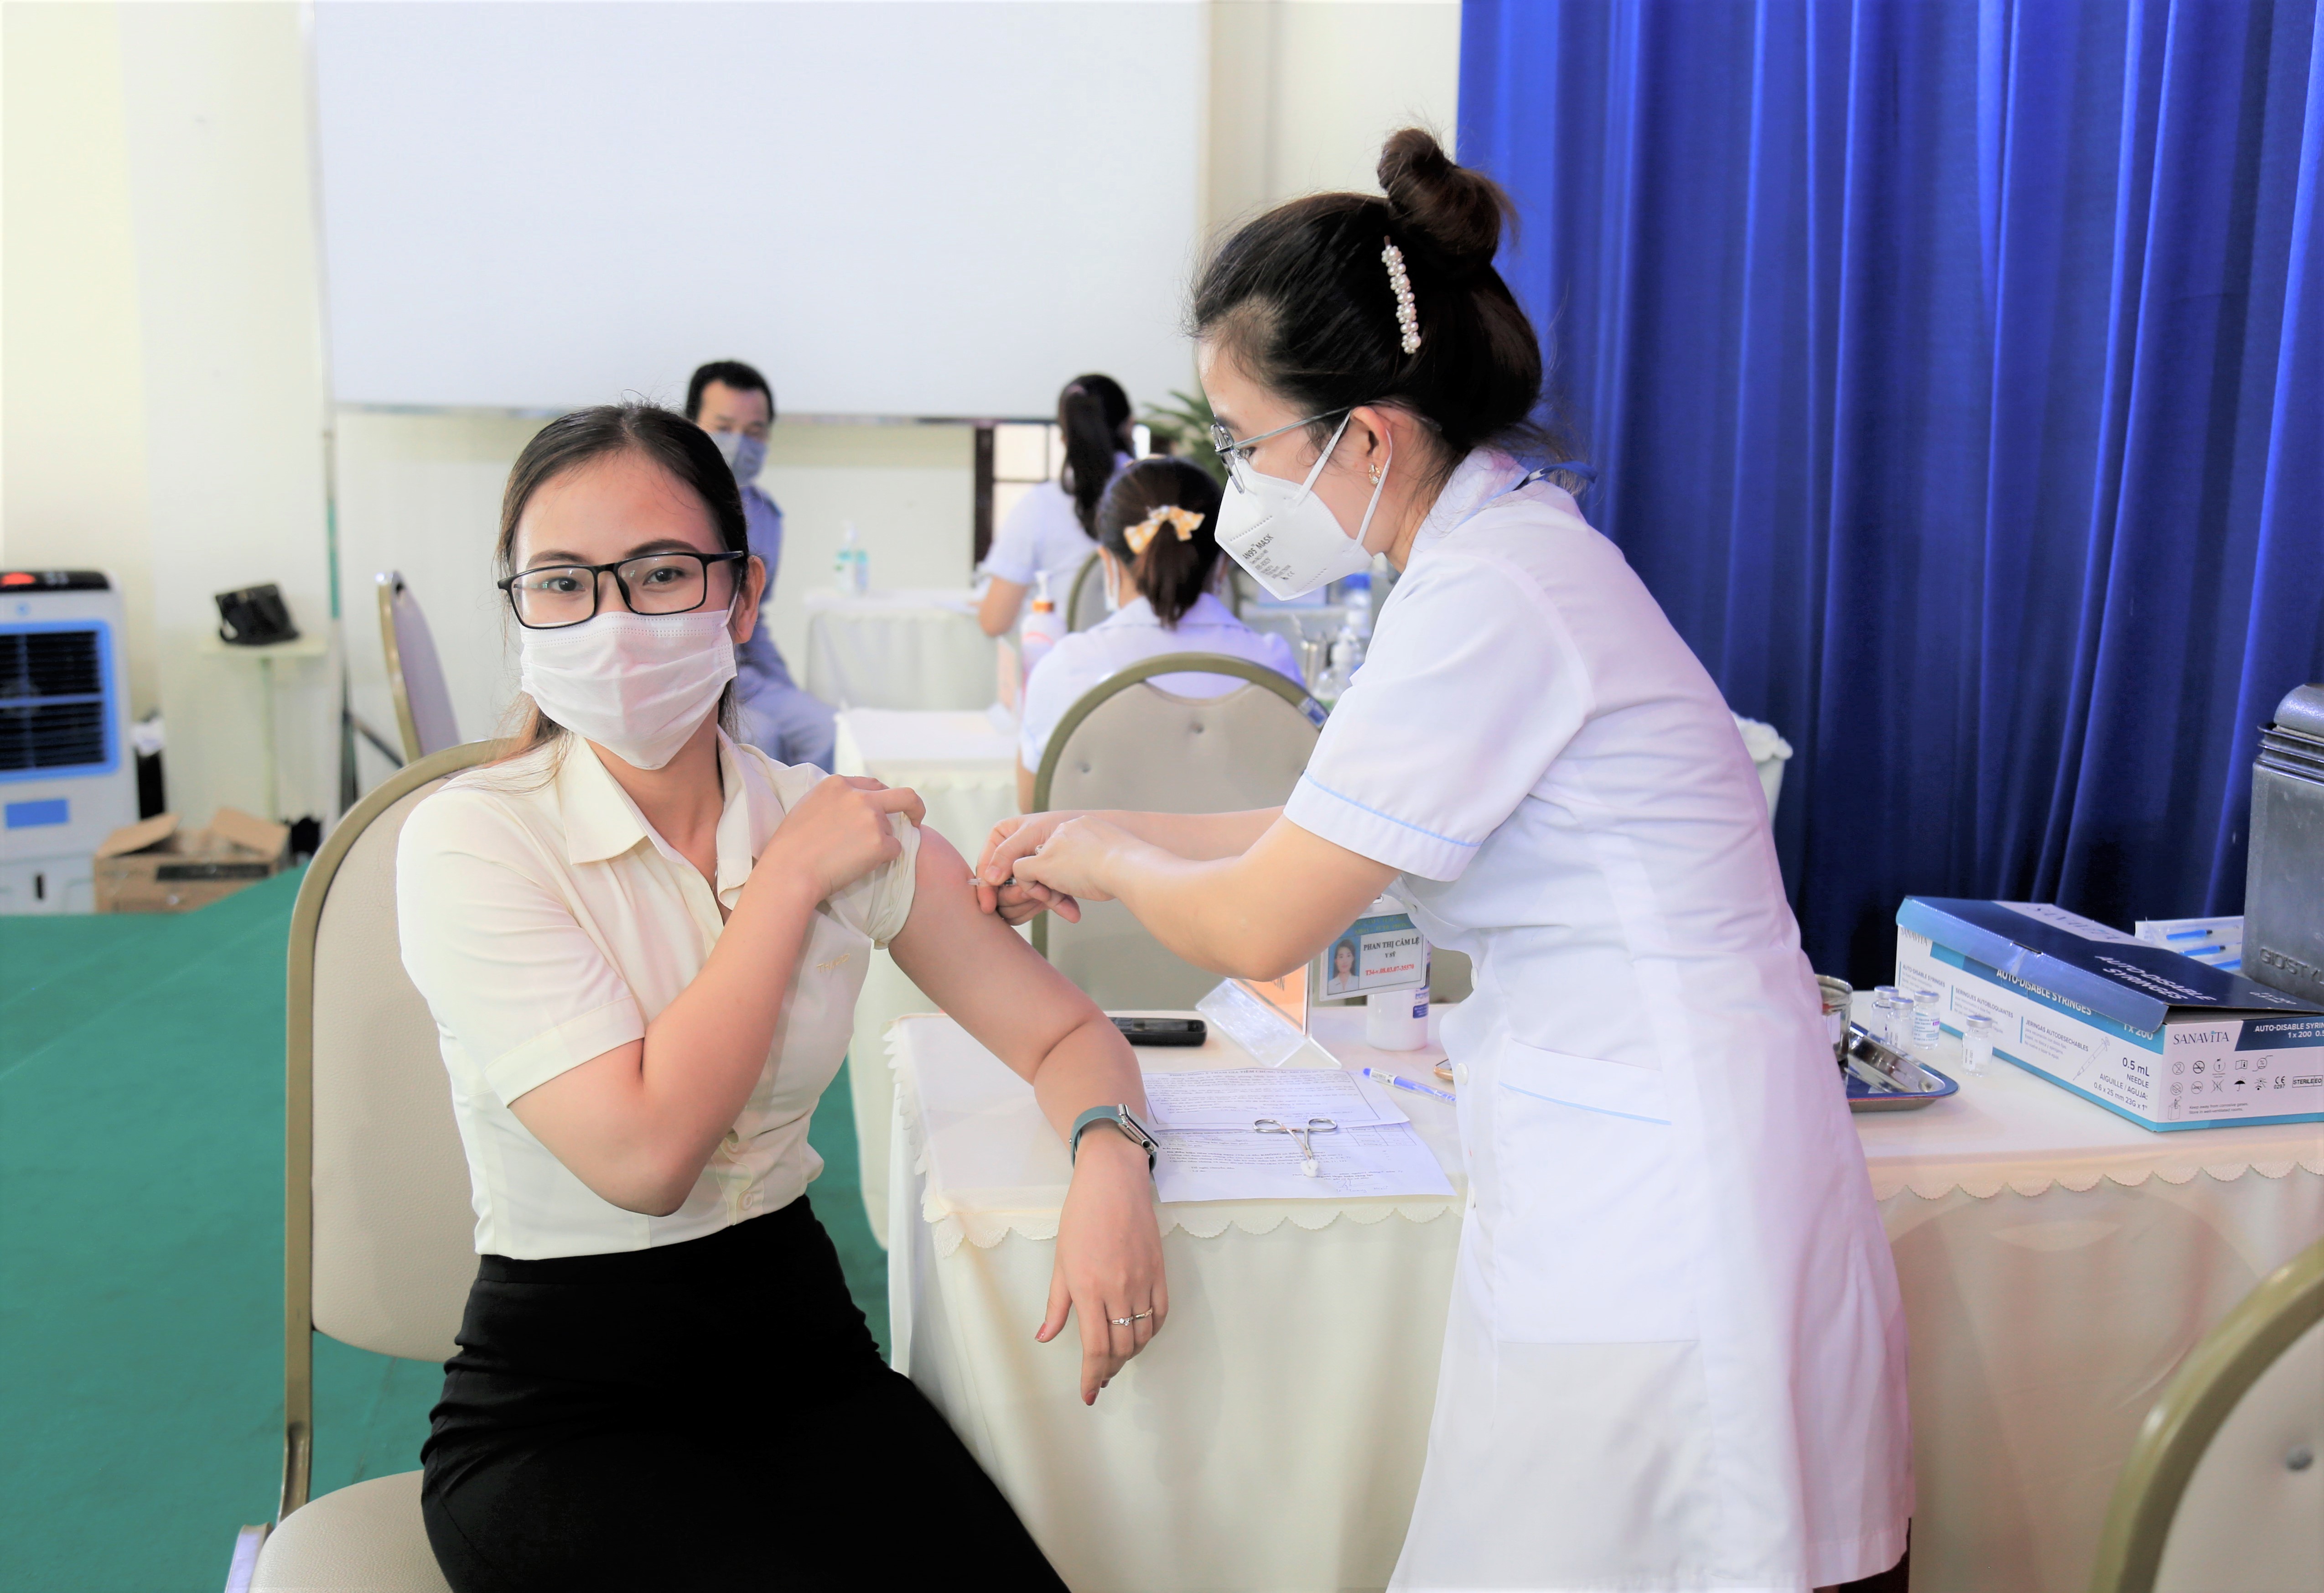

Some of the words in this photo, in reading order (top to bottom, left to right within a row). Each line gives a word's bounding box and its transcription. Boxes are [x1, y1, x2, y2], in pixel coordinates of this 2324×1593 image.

[1255, 533, 1274, 550] MASK
[1364, 942, 1381, 951] PHAN
[1382, 941, 1394, 949] THỊ
[2094, 955, 2217, 1001] AUTO-DISABLE
[2102, 968, 2189, 1000] SYRINGES
[1996, 968, 2051, 999] AUTO-DISABLE
[2051, 990, 2092, 1016] SYRINGES
[1976, 997, 2013, 1018] AUTOBLOQUANTES
[2025, 1019, 2046, 1033] JERINGAS
[2046, 1029, 2089, 1052] AUTODESECHABLES
[2255, 1023, 2304, 1032] AUTO-DISABLE
[2122, 1057, 2135, 1070] 0.5
[2137, 1066, 2150, 1077] mL
[2100, 1073, 2123, 1089] AIGUILLE
[2127, 1086, 2148, 1100] AGUJA:
[2127, 1073, 2149, 1088] NEEDLE
[2094, 1082, 2102, 1091] 0.6
[2107, 1088, 2114, 1097] 25
[2115, 1093, 2124, 1102] mm
[2125, 1097, 2136, 1107] 23G
